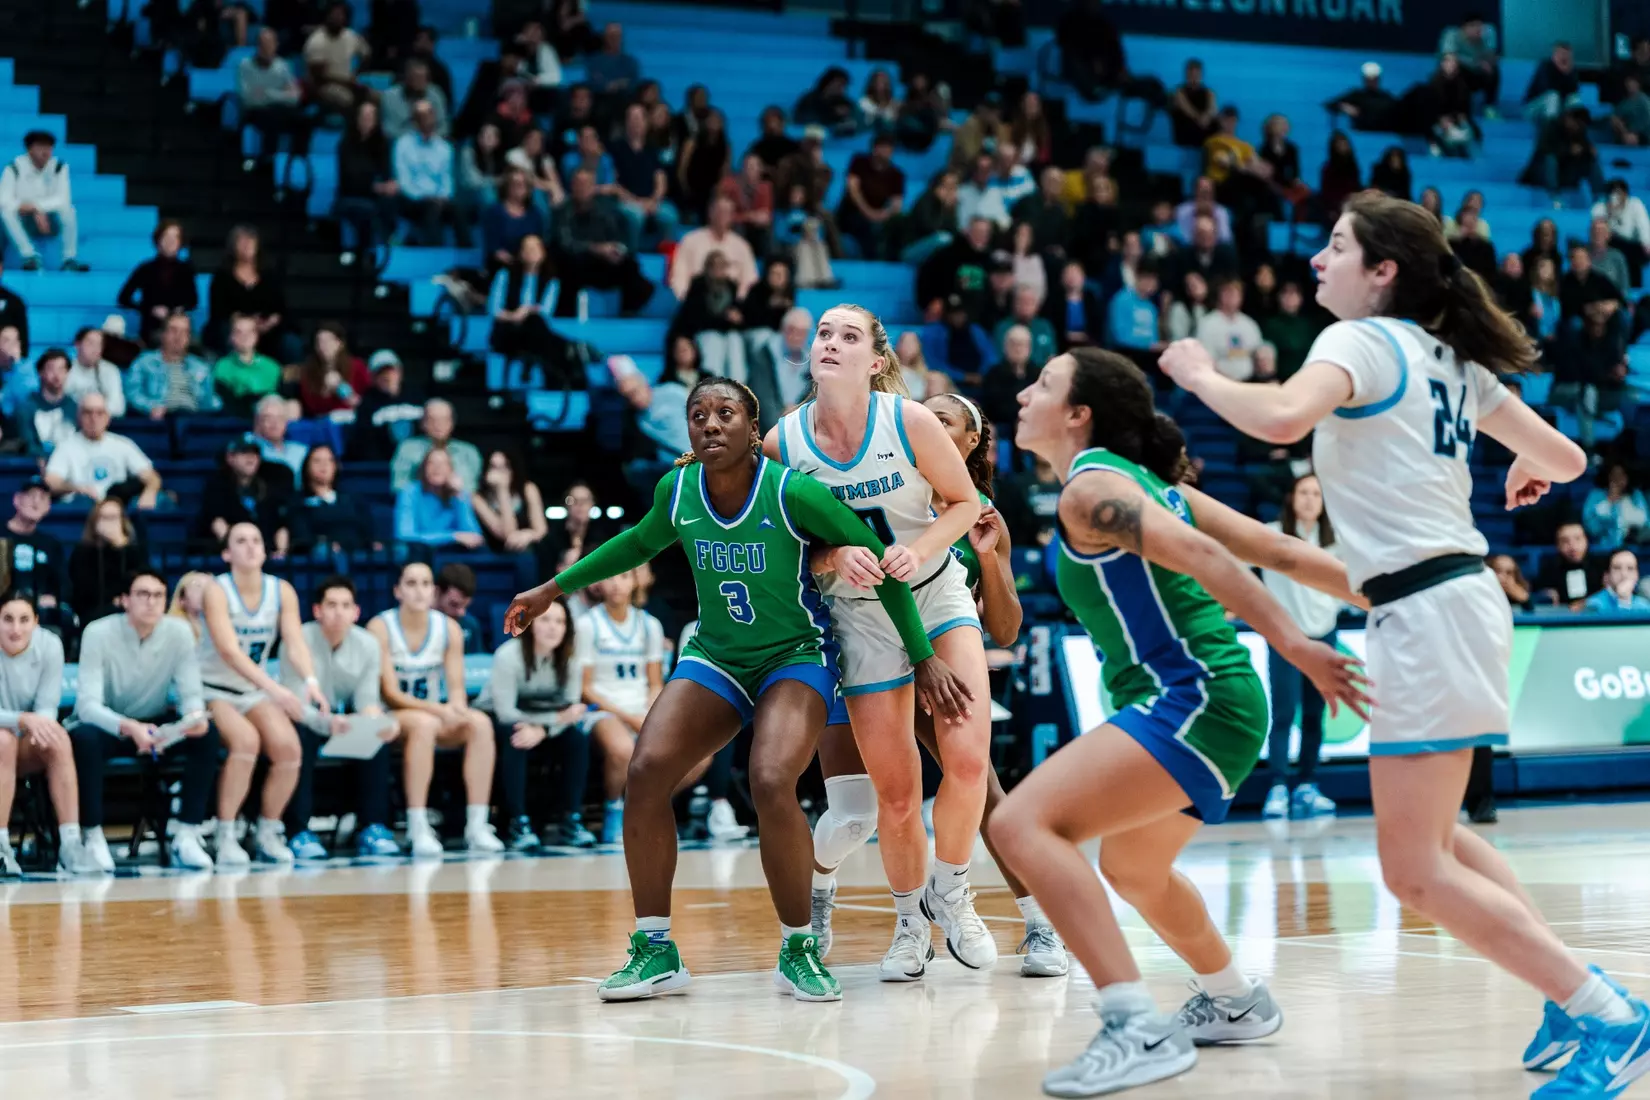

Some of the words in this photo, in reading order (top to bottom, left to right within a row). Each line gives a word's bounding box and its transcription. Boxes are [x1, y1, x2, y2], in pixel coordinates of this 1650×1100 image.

[1428, 378, 1474, 465] 24
[694, 538, 767, 574] FGCU
[719, 580, 756, 625] 3
